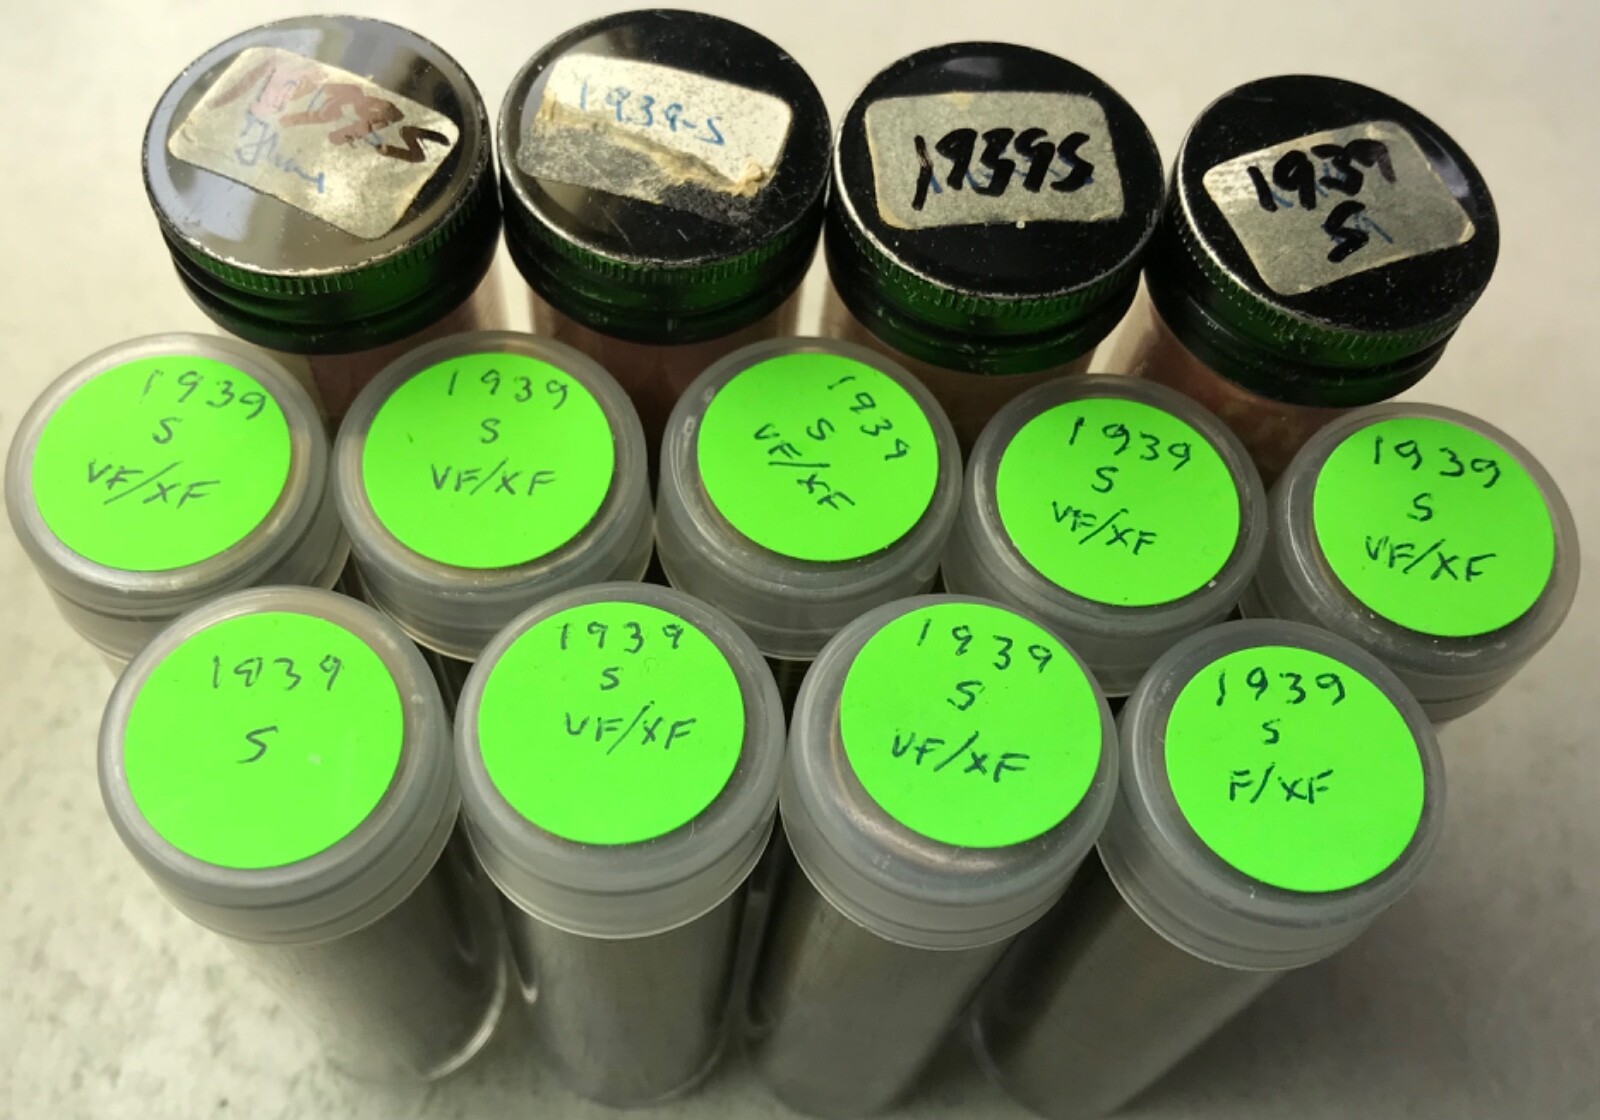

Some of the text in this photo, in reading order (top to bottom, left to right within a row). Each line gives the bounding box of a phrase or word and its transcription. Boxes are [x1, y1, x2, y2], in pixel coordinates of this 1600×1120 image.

[911, 127, 1095, 212] 1939S
[1246, 138, 1397, 213] 1939
[1322, 199, 1370, 263] S
[140, 370, 269, 420] 1939
[447, 367, 570, 411] 1939
[152, 416, 182, 446] S
[480, 418, 502, 445] S
[805, 416, 836, 441] S
[826, 375, 911, 462] 1939
[1067, 415, 1193, 473] 1939
[1372, 435, 1502, 489] 1939
[86, 459, 221, 510] VF/XF
[430, 457, 556, 497] VF/XF
[1090, 465, 1119, 494] S
[1051, 500, 1158, 557] VF/XF
[1410, 492, 1434, 522] S
[1364, 536, 1498, 583] VF/XF
[558, 620, 685, 655] 1939
[915, 617, 1054, 674] 1939
[208, 653, 345, 693] 1939
[598, 666, 621, 692] S
[1214, 665, 1347, 708] 1939
[946, 680, 986, 713] S
[236, 725, 279, 765] S
[563, 699, 699, 757] VF/XF
[1260, 719, 1282, 745] S
[890, 729, 1031, 784] VF/XF
[1228, 762, 1335, 806] F/XF
